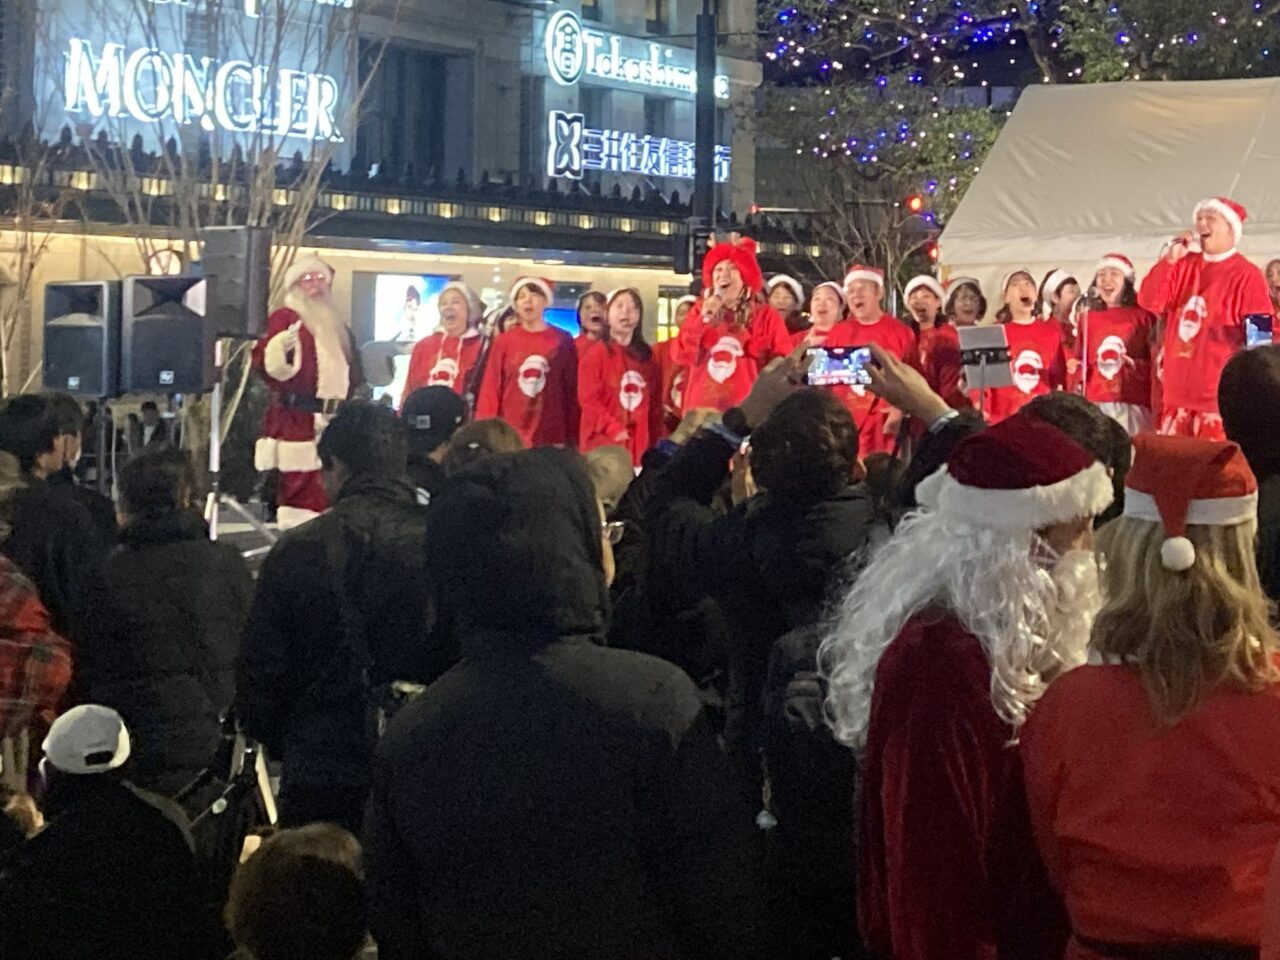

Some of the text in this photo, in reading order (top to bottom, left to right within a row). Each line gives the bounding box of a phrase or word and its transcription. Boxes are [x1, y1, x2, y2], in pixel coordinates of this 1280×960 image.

[64, 38, 345, 142] MONCLER
[583, 29, 730, 100] Takashima
[582, 129, 732, 183] 三井住友信託行
